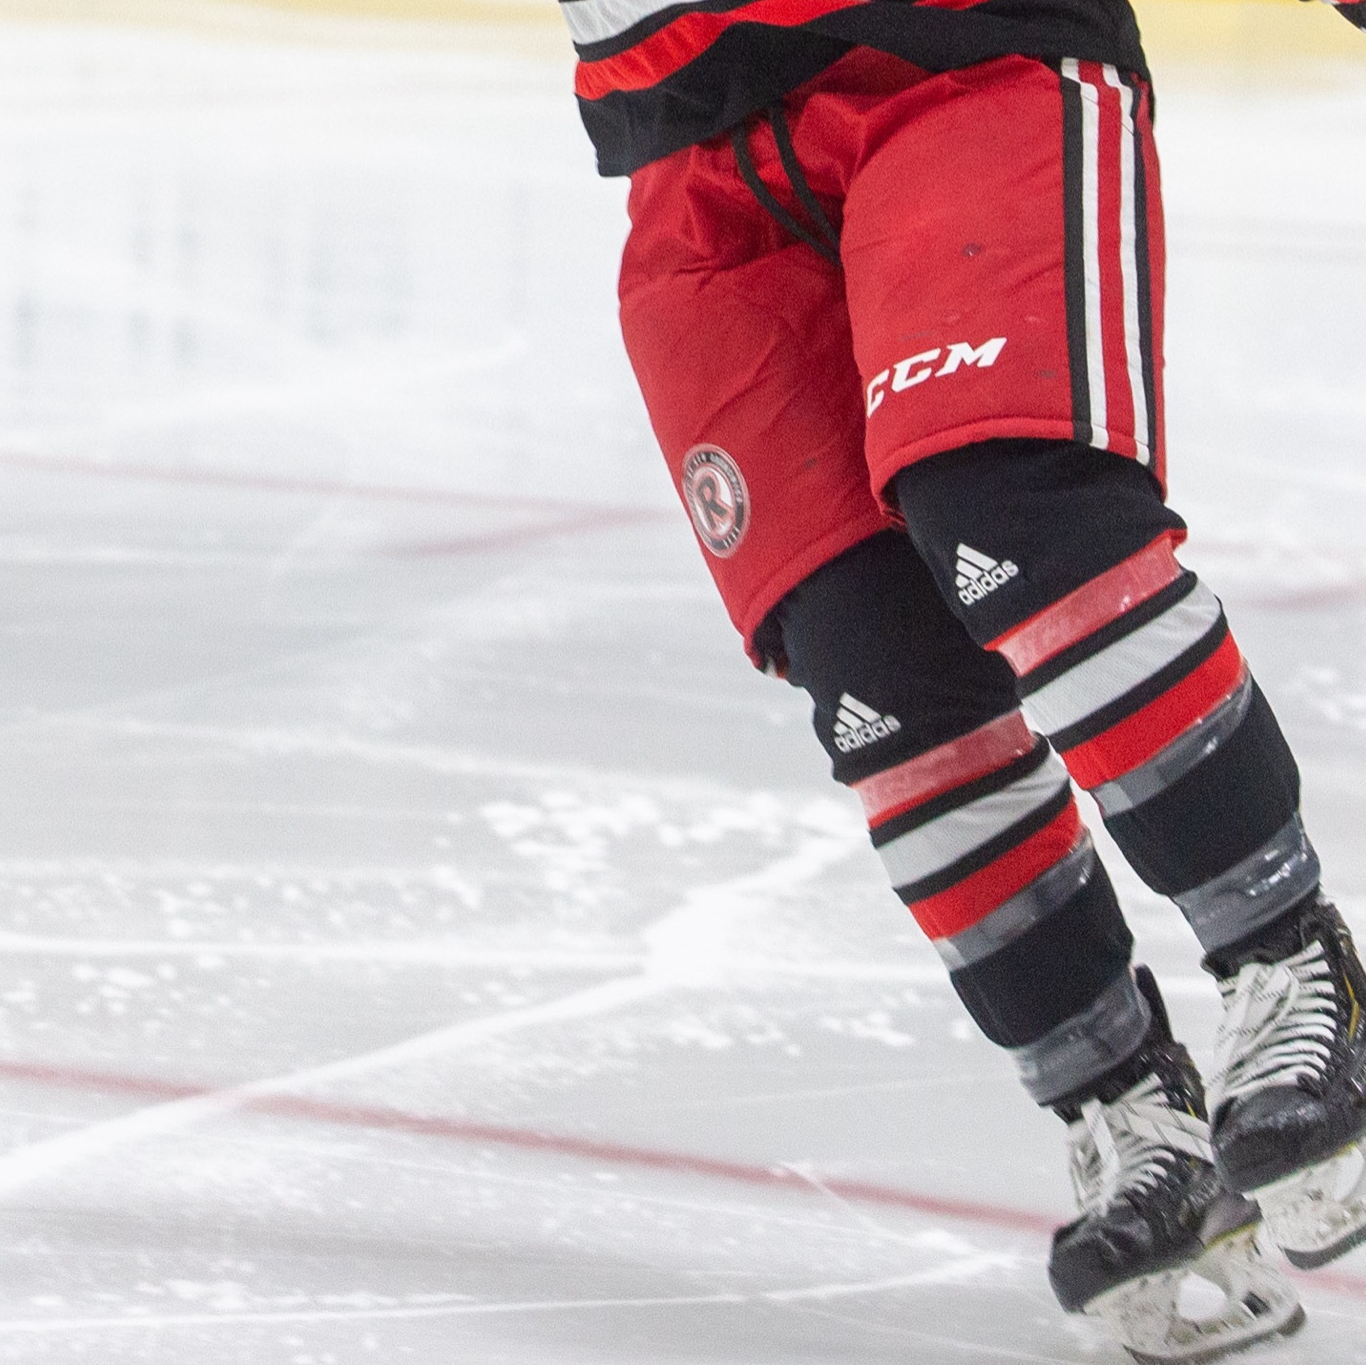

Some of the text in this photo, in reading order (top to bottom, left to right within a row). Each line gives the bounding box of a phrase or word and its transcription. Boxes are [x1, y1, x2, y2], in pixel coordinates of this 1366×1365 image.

[867, 337, 1007, 419] CCM
[958, 560, 1019, 606] adidas
[834, 715, 901, 753] adidas
